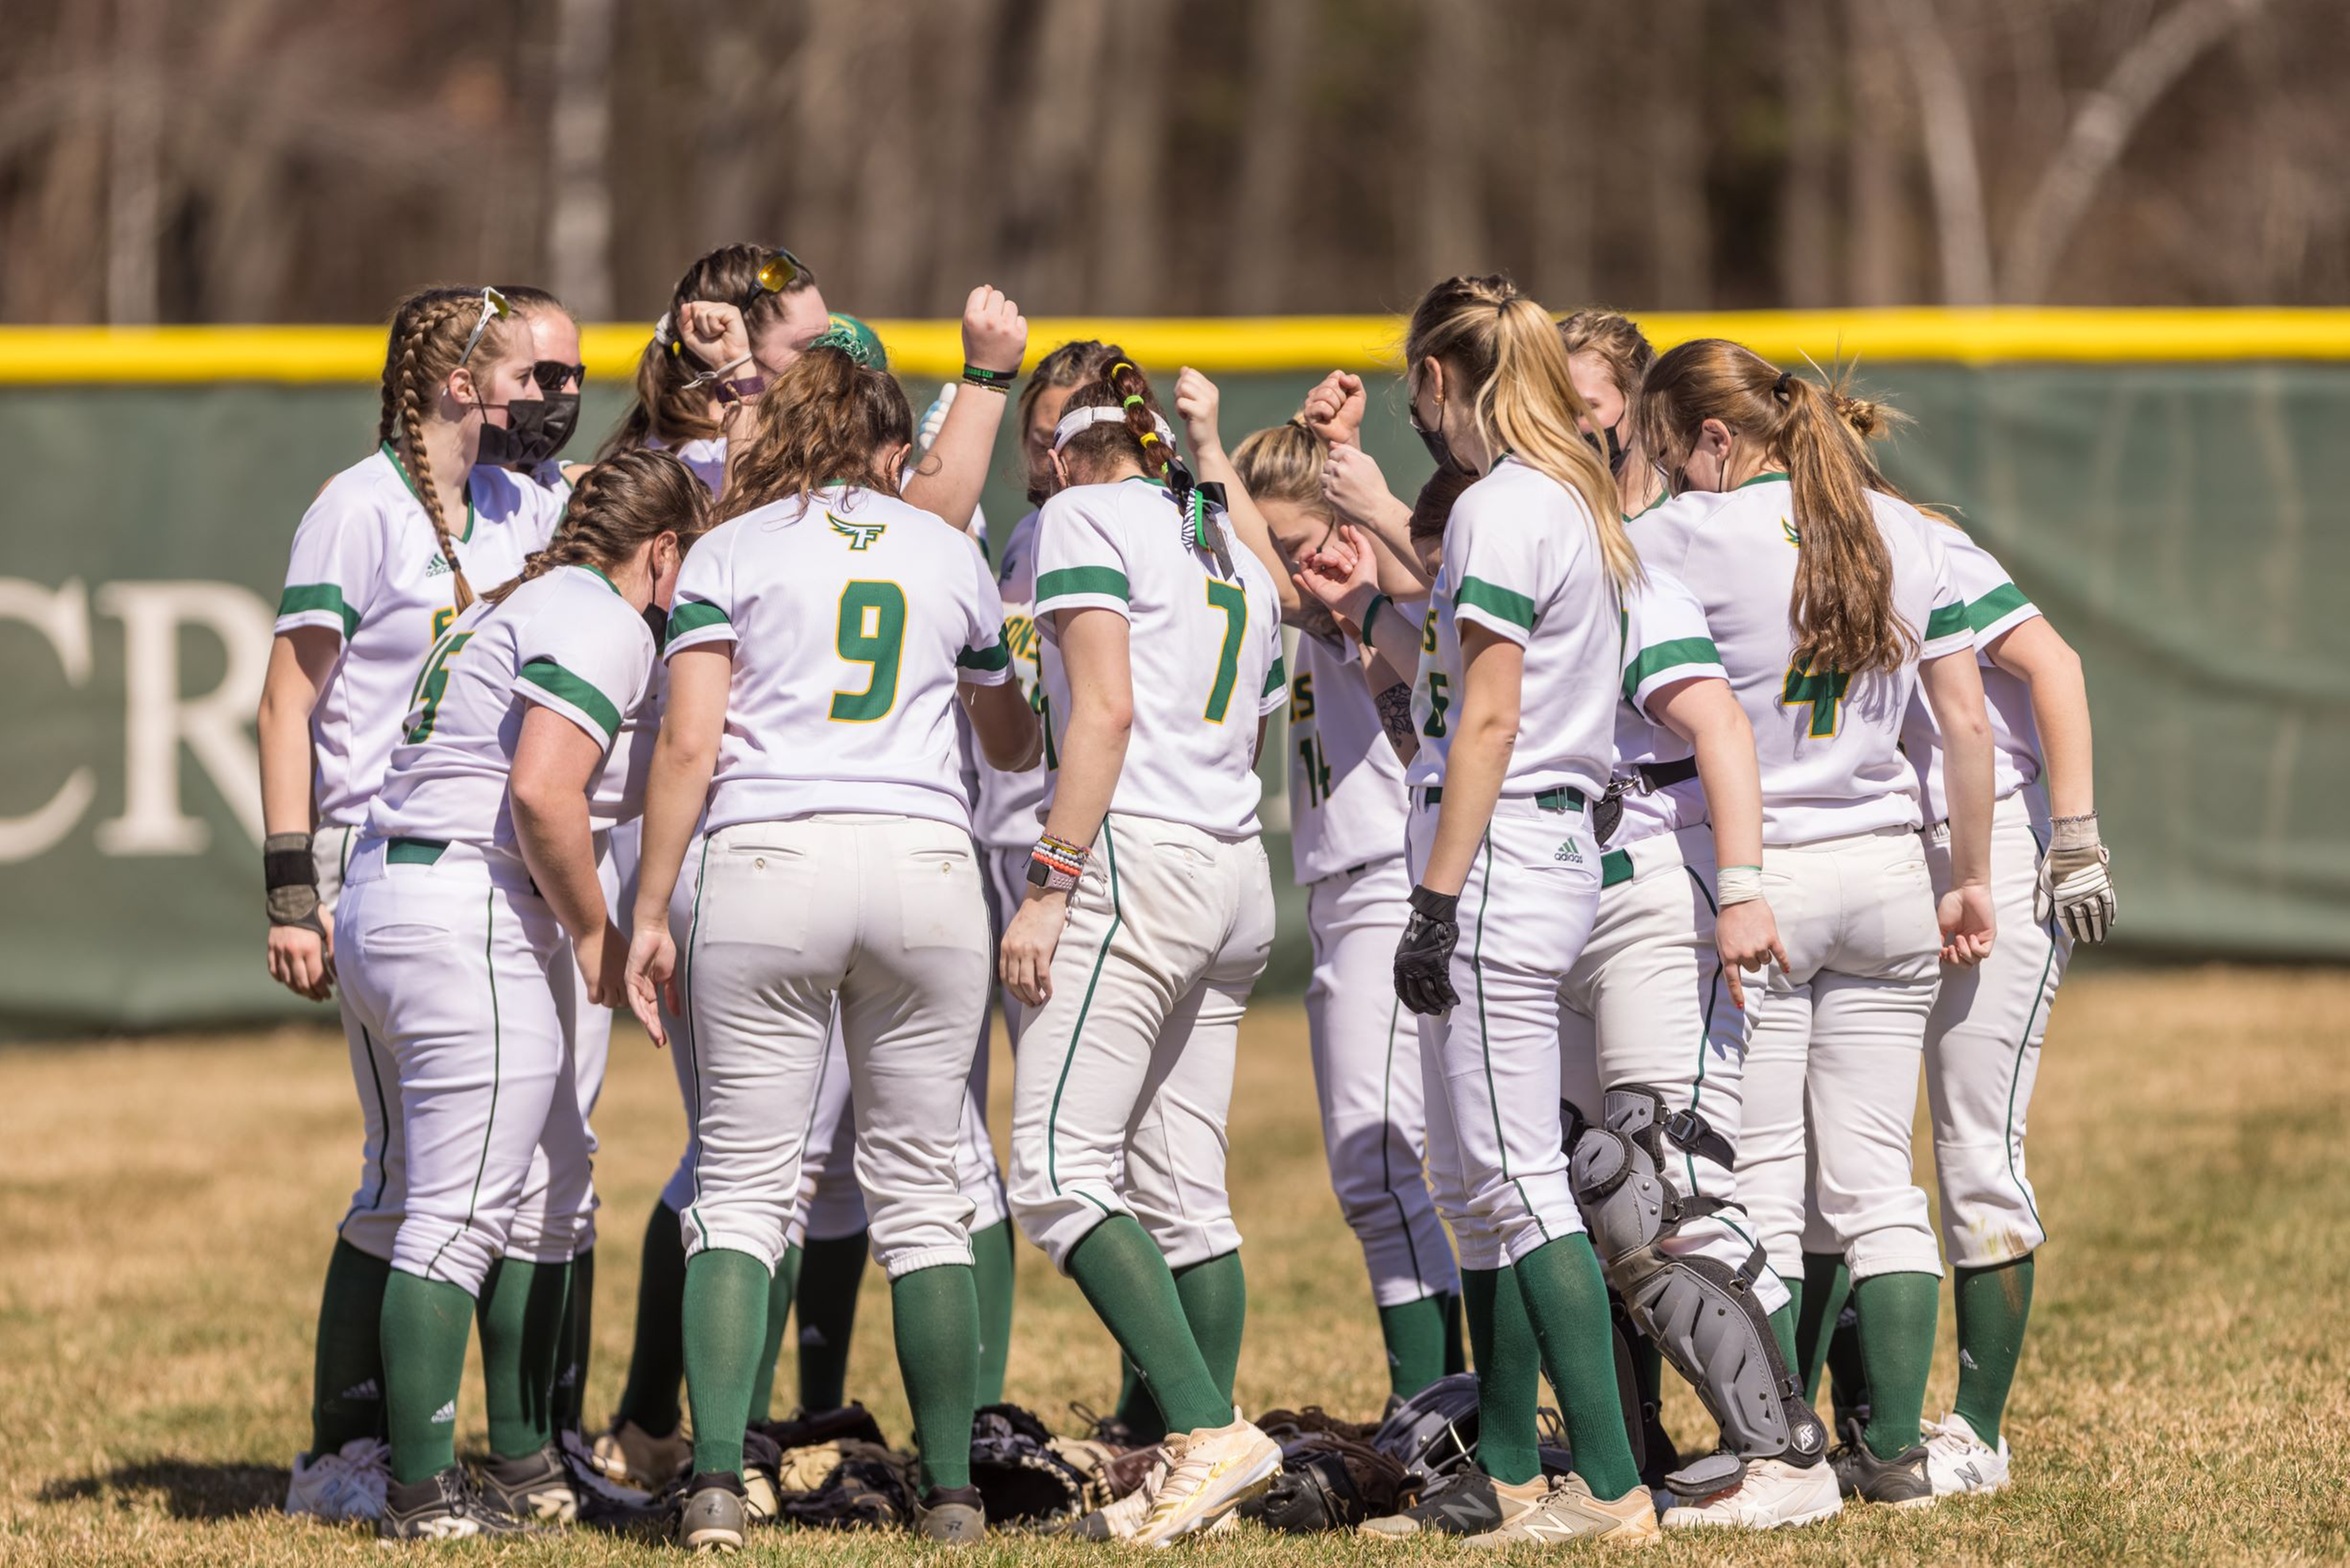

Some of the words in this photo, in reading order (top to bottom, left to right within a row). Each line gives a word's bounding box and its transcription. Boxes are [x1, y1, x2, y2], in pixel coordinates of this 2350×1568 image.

[828, 578, 908, 724] 9
[1202, 575, 1248, 726] 7
[1782, 645, 1854, 740] 4
